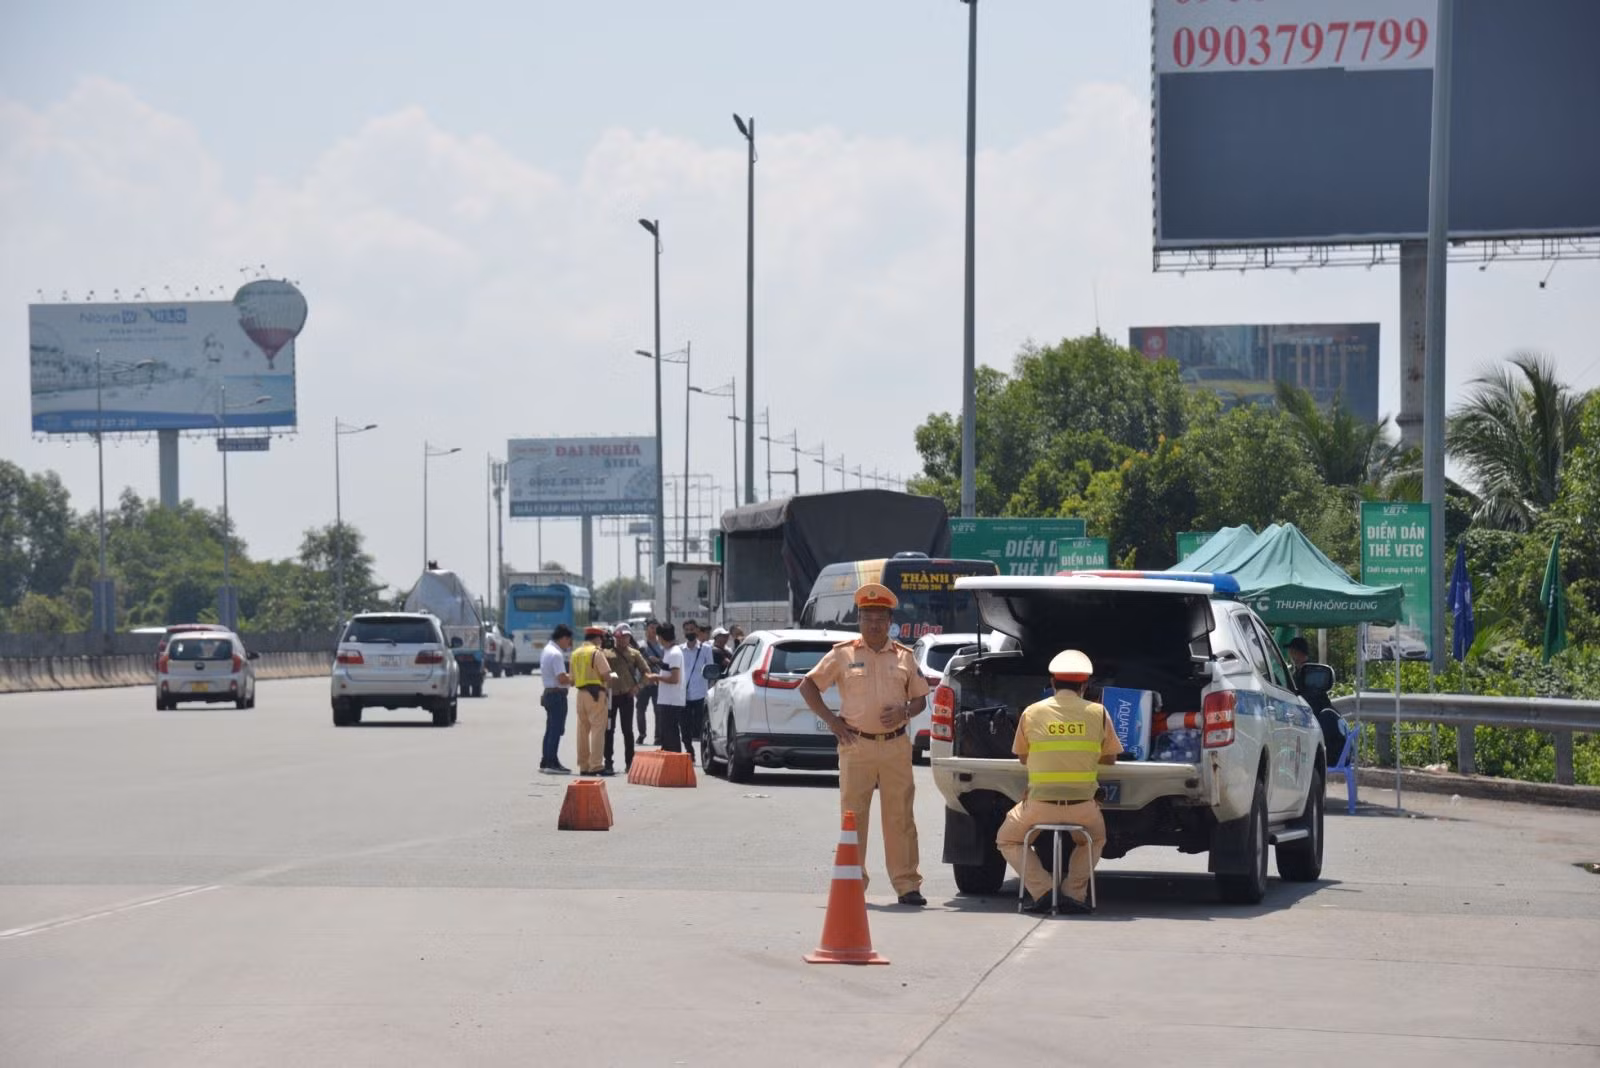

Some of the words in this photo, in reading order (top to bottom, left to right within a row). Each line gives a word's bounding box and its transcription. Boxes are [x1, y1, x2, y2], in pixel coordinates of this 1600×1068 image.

[1173, 17, 1428, 68] 0903797799
[604, 458, 641, 468] STEEL
[1366, 520, 1397, 540] ĐIỂM
[1401, 522, 1425, 540] DÁN
[1005, 534, 1046, 558] ĐIỂM
[1368, 539, 1392, 558] THẺ
[1394, 543, 1424, 558] VETC
[1086, 552, 1105, 566] DÁN
[901, 570, 949, 583] THÀNH
[1275, 600, 1296, 609] THU
[1295, 598, 1313, 610] PHÍ
[1313, 599, 1348, 611] KHÔNG
[1049, 724, 1084, 736] CSGT
